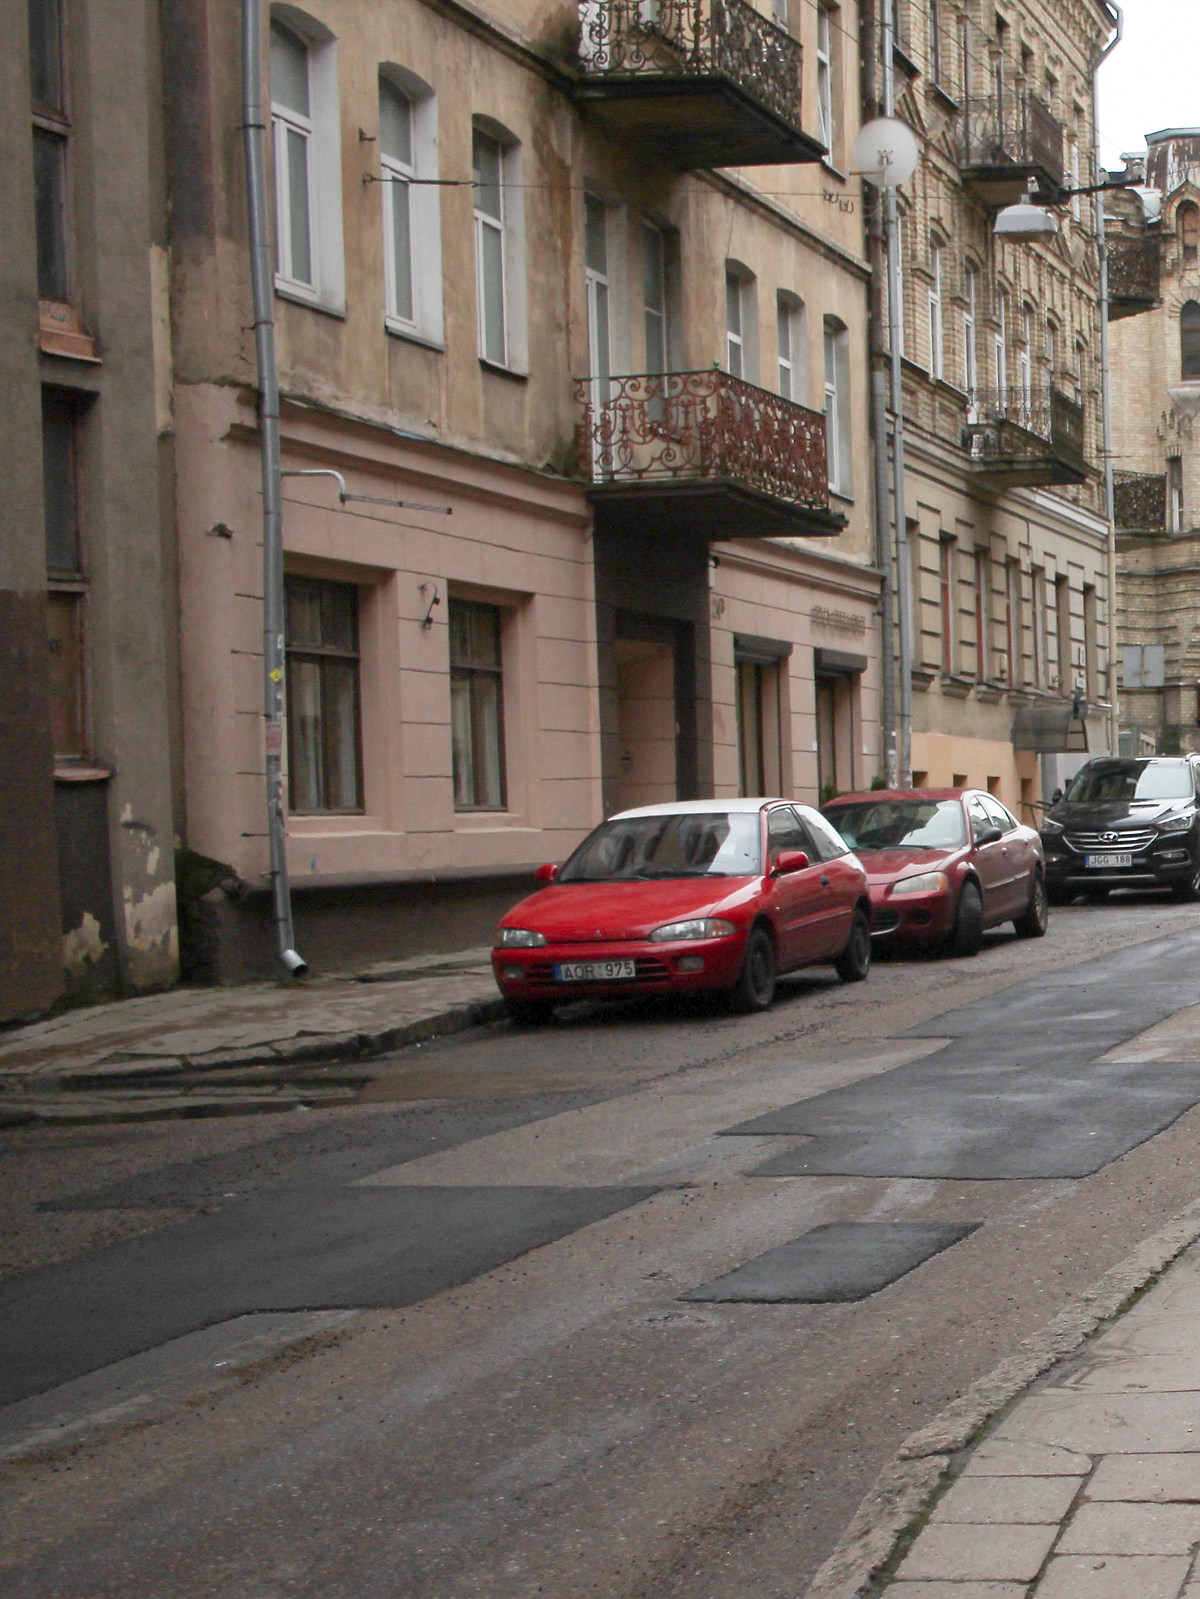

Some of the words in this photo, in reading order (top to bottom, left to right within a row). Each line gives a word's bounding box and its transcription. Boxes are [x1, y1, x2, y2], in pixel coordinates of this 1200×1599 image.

[1091, 855, 1109, 864] JGG
[564, 964, 596, 980] AOR
[605, 961, 633, 977] 975
